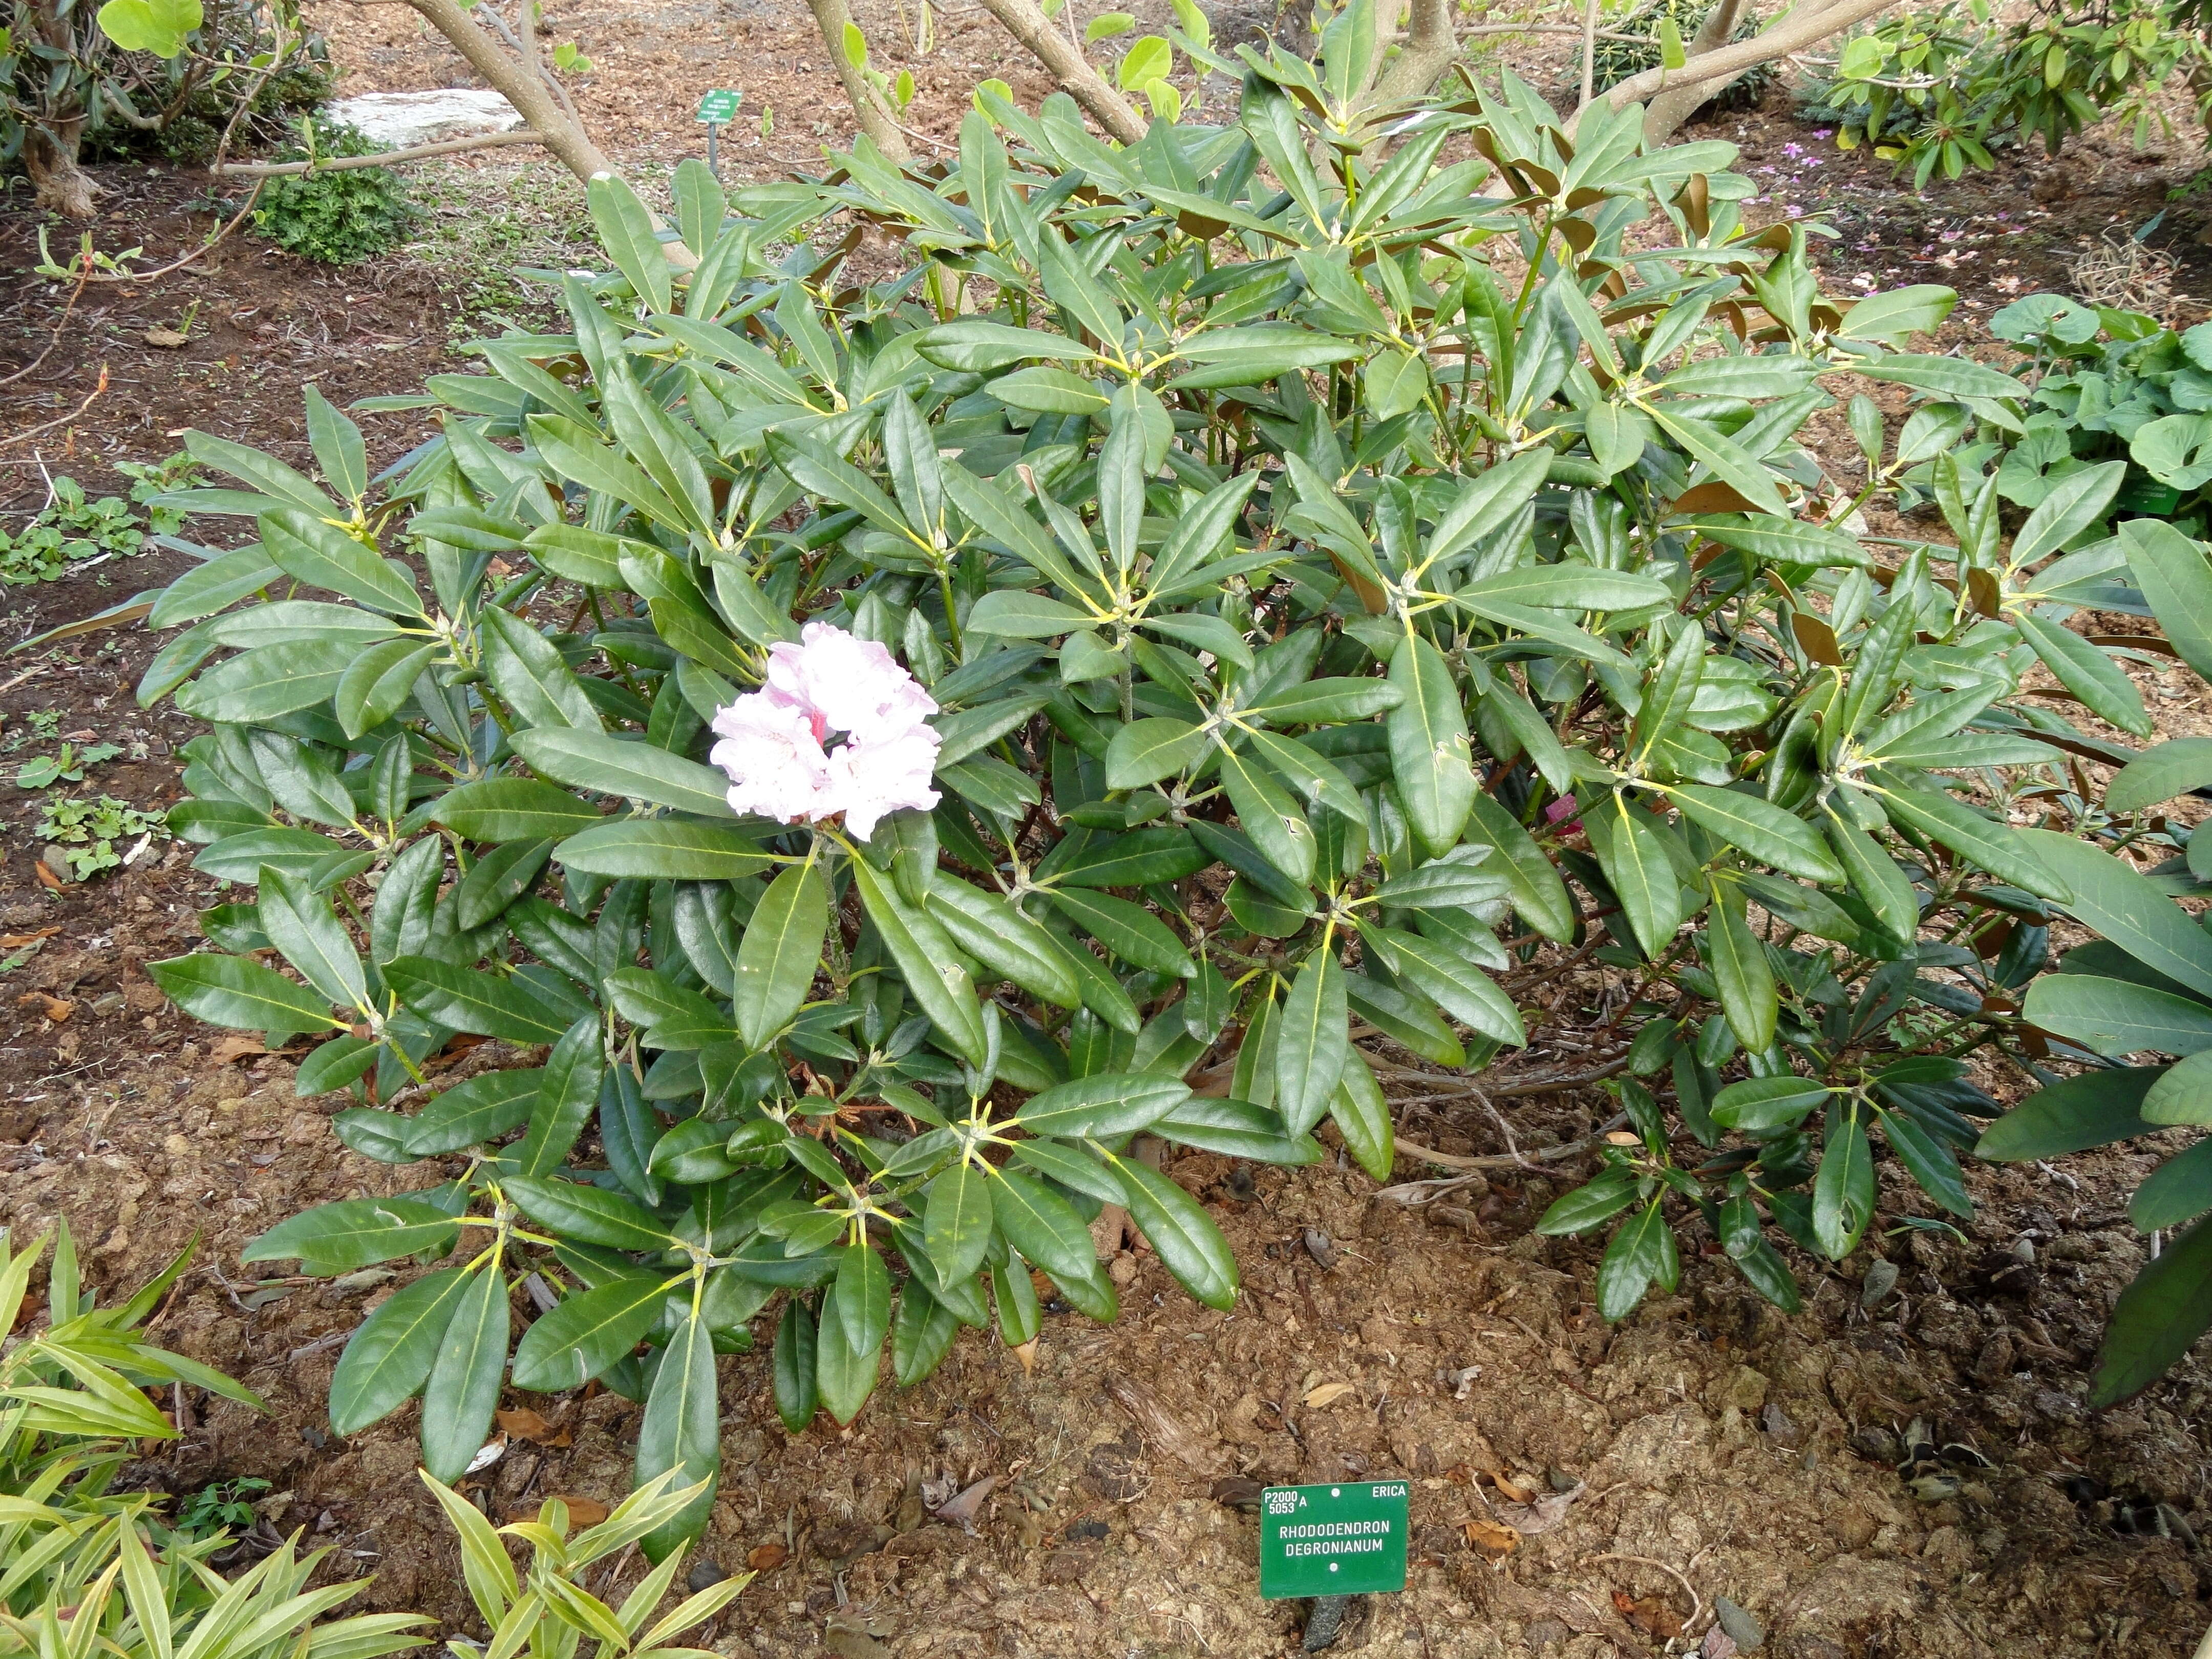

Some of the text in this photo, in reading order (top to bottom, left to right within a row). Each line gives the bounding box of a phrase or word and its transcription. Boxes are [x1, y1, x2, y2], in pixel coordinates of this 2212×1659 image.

[1265, 1491, 1307, 1507] P2000 A
[1373, 1485, 1406, 1497] ERICA
[1269, 1503, 1294, 1514] 5053
[1280, 1520, 1389, 1539] RHODODENDRON
[1286, 1539, 1382, 1556] DEGRONIANUM
